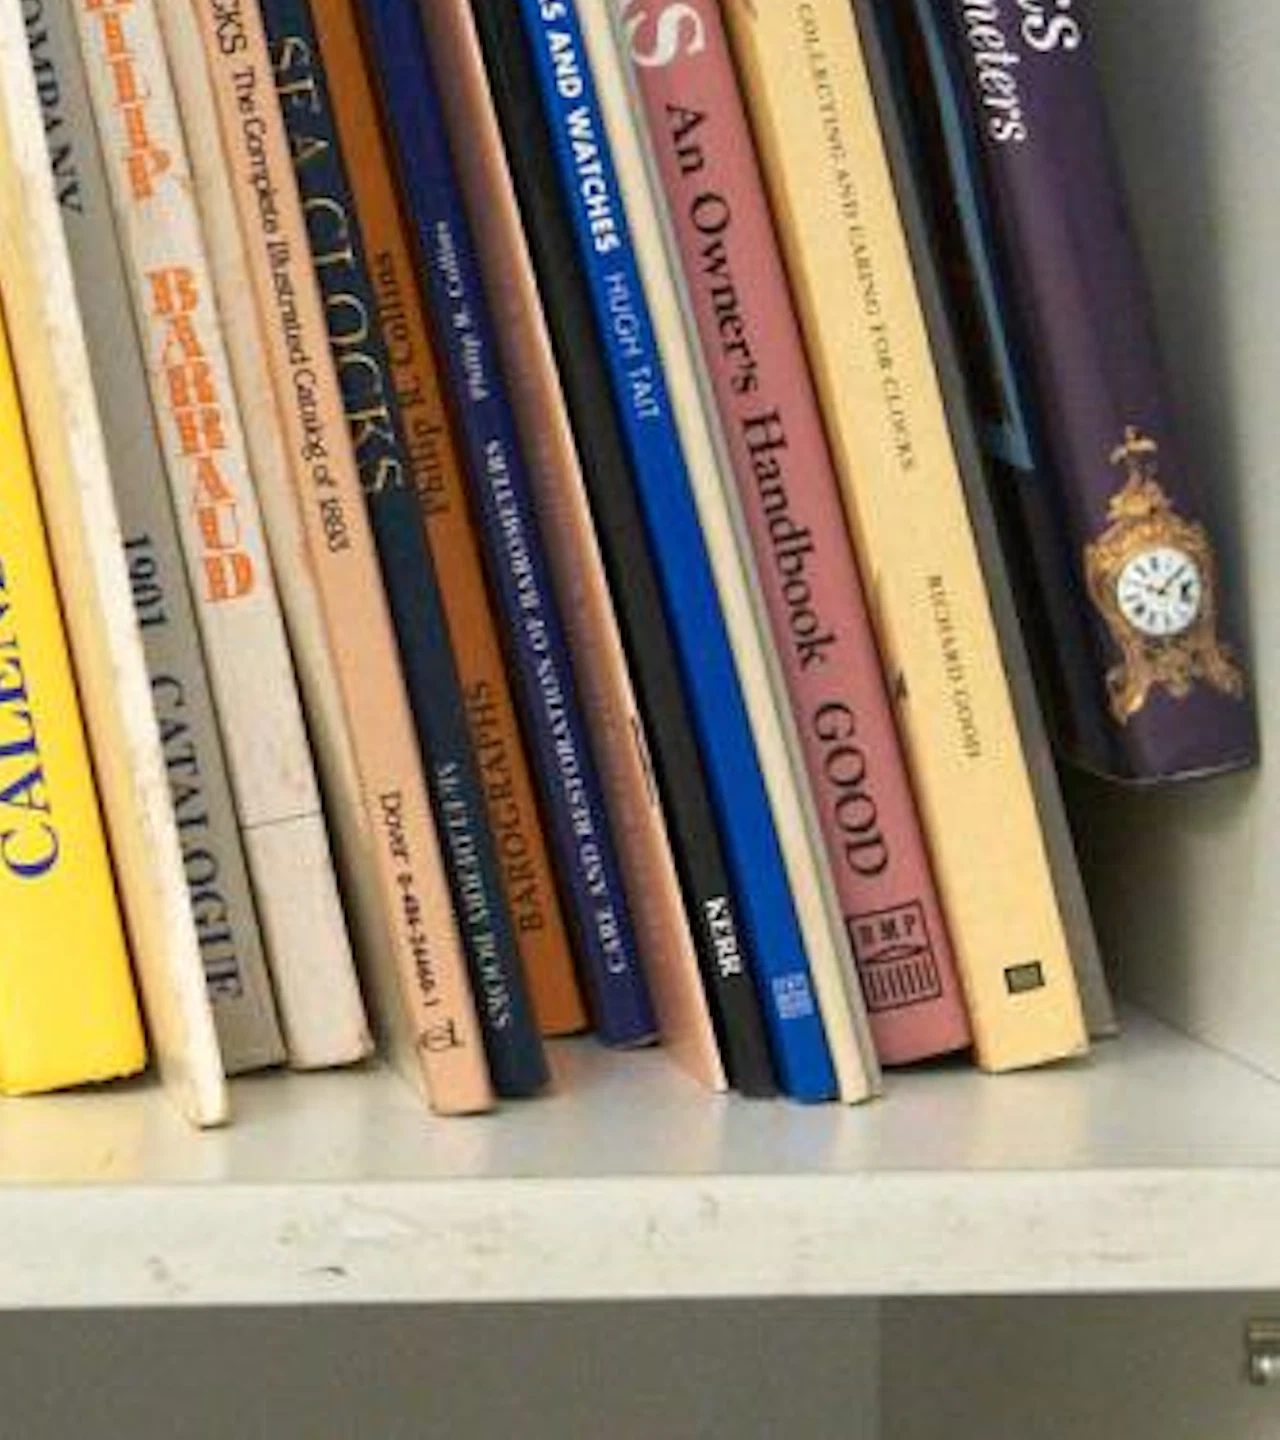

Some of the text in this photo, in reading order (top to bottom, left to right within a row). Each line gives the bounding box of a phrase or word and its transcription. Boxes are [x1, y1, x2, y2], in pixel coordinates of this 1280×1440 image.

[234, 66, 260, 113] The
[240, 115, 282, 233] Complete
[546, 30, 583, 100] AND
[565, 108, 621, 253] WATCHES
[604, 272, 639, 363] HUGH
[266, 239, 307, 366] Illustrated
[273, 34, 405, 493] SEA CLOCKS
[286, 366, 327, 461] Catalog
[310, 461, 336, 491] of
[666, 101, 710, 177] An
[688, 193, 760, 395] Owner's
[741, 409, 839, 673] Handbook
[814, 700, 891, 878] GOOD
[149, 674, 244, 1000] CATALOGUE
[467, 679, 545, 935] BAROGRAPHS
[704, 896, 742, 977] KERR
